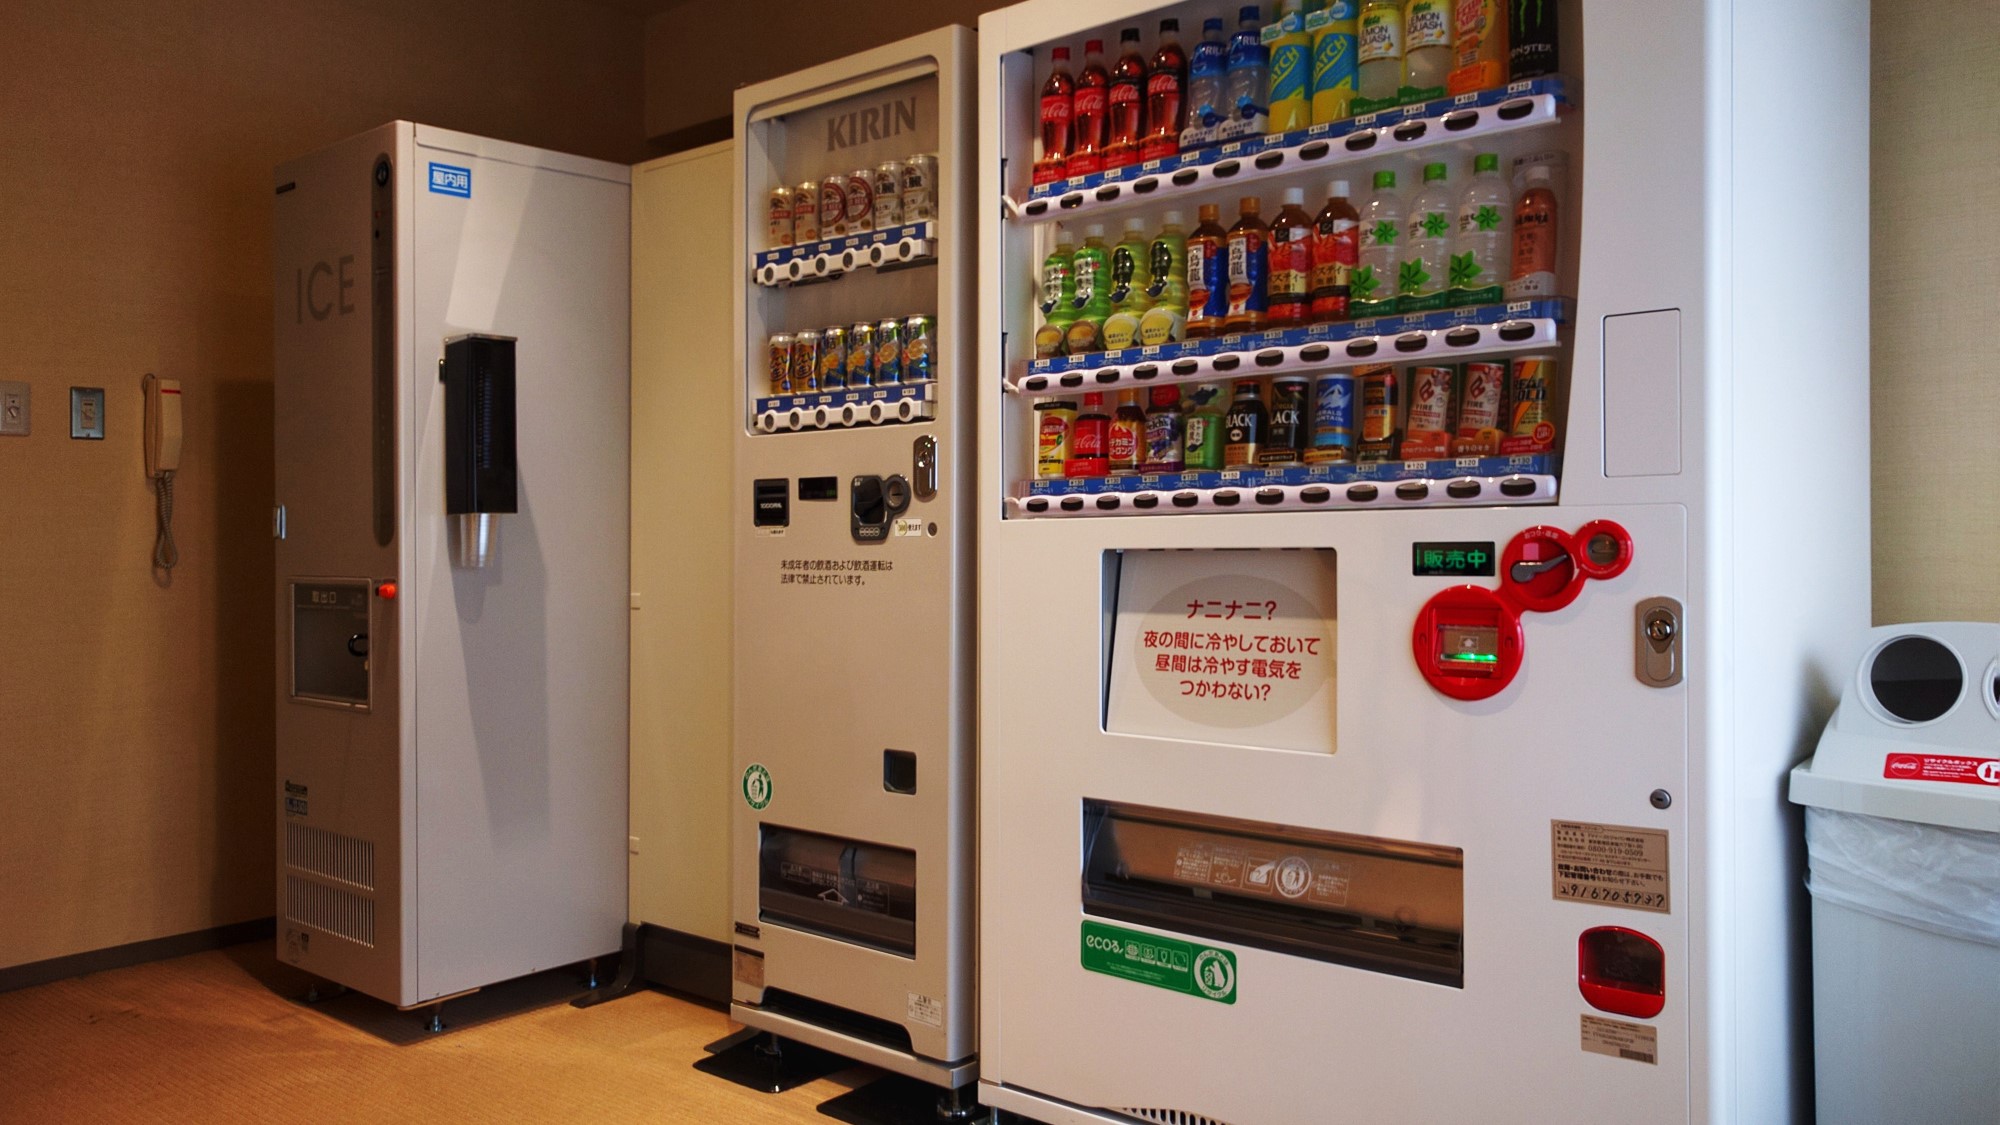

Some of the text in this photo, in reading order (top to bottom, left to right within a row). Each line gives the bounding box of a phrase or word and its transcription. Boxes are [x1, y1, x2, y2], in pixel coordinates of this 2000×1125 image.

[1315, 35, 1347, 72] ATCH
[1511, 43, 1552, 57] ONSTER
[1271, 47, 1299, 82] ATCH
[827, 96, 916, 152] KIRIN
[296, 254, 354, 324] ICE
[780, 560, 893, 572] 未成年者の飲酒および飲酒運転は
[1424, 549, 1487, 569] 販売中
[780, 574, 866, 586] 法律で禁止されています。
[1186, 599, 1277, 620] ナニナニ?
[1143, 630, 1321, 655] 夜の間に冷やしておいて
[1155, 653, 1302, 679] 昼間は冷やす電気を
[1179, 679, 1271, 701] つかわない?
